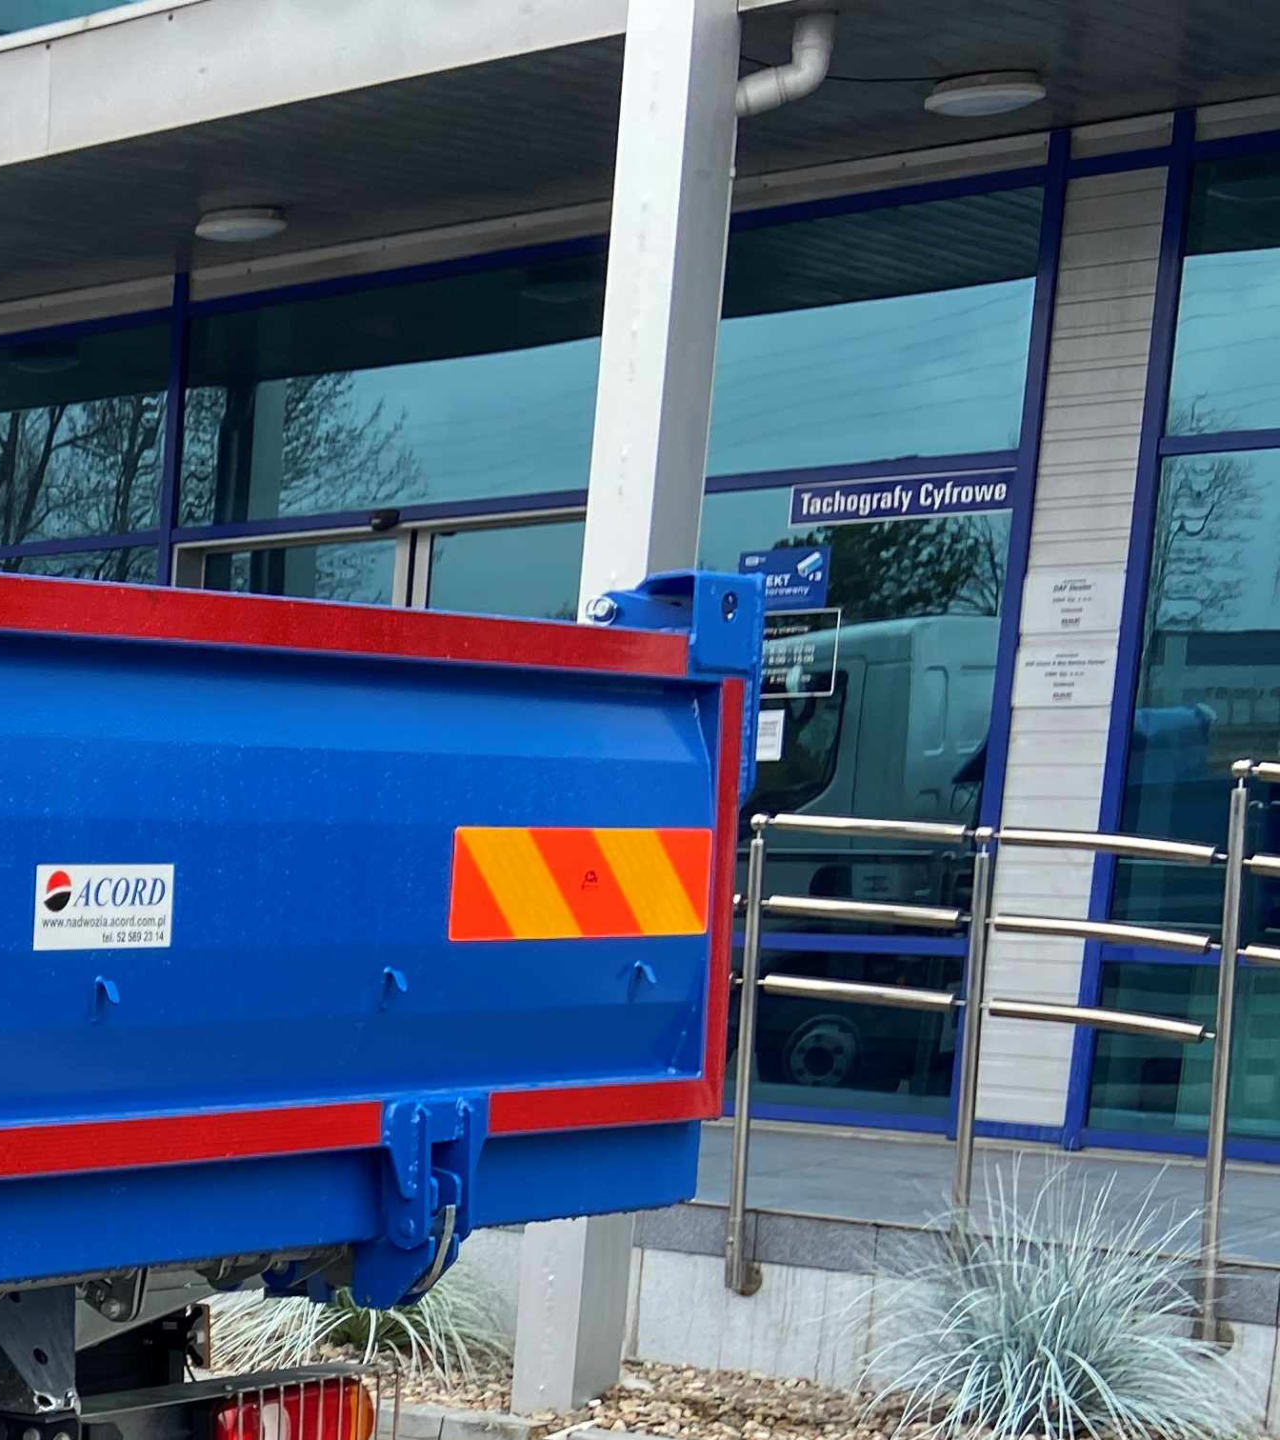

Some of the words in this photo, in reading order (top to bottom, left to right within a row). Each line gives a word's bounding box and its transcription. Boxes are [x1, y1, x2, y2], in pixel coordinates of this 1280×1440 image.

[801, 485, 913, 516] Tachografy
[919, 481, 1008, 510] Cyfrowe
[765, 573, 791, 587] EKT
[73, 877, 166, 907] ACORD
[41, 914, 166, 929] www.nadwozia.acord.com.pl
[116, 931, 126, 943] 52
[155, 931, 164, 941] 14
